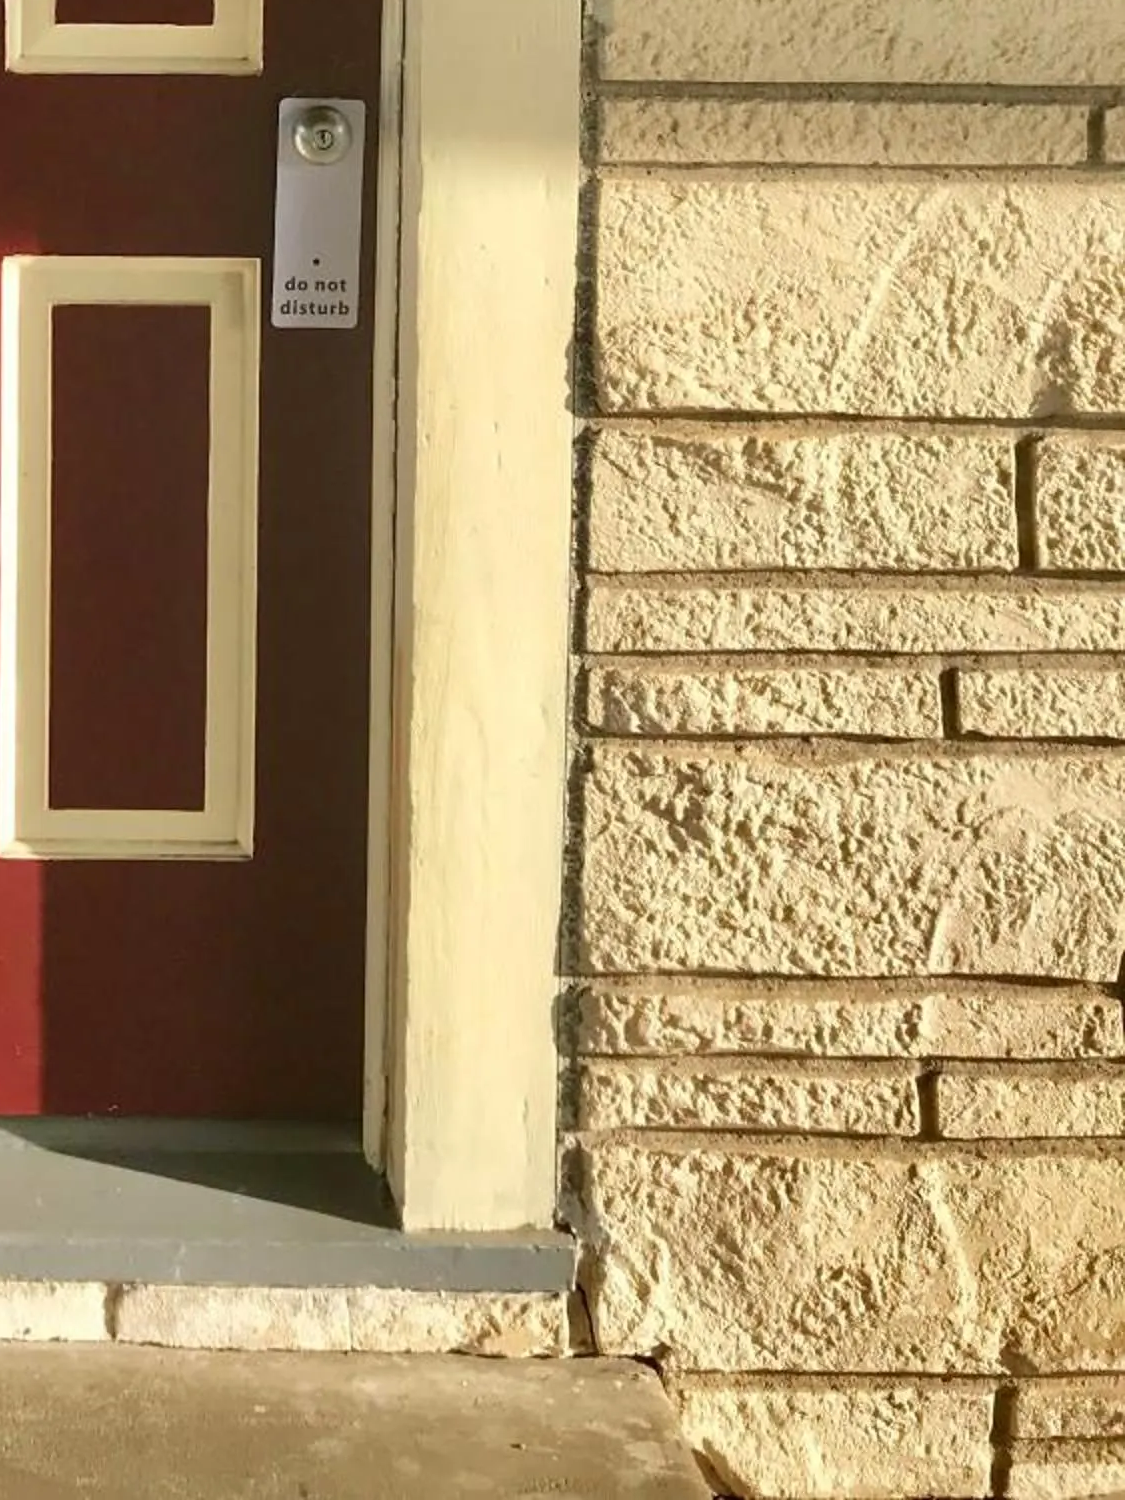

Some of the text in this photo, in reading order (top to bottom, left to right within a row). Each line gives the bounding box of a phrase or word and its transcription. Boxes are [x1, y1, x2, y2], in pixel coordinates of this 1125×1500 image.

[284, 275, 347, 292] do not
[280, 299, 350, 315] disturb
